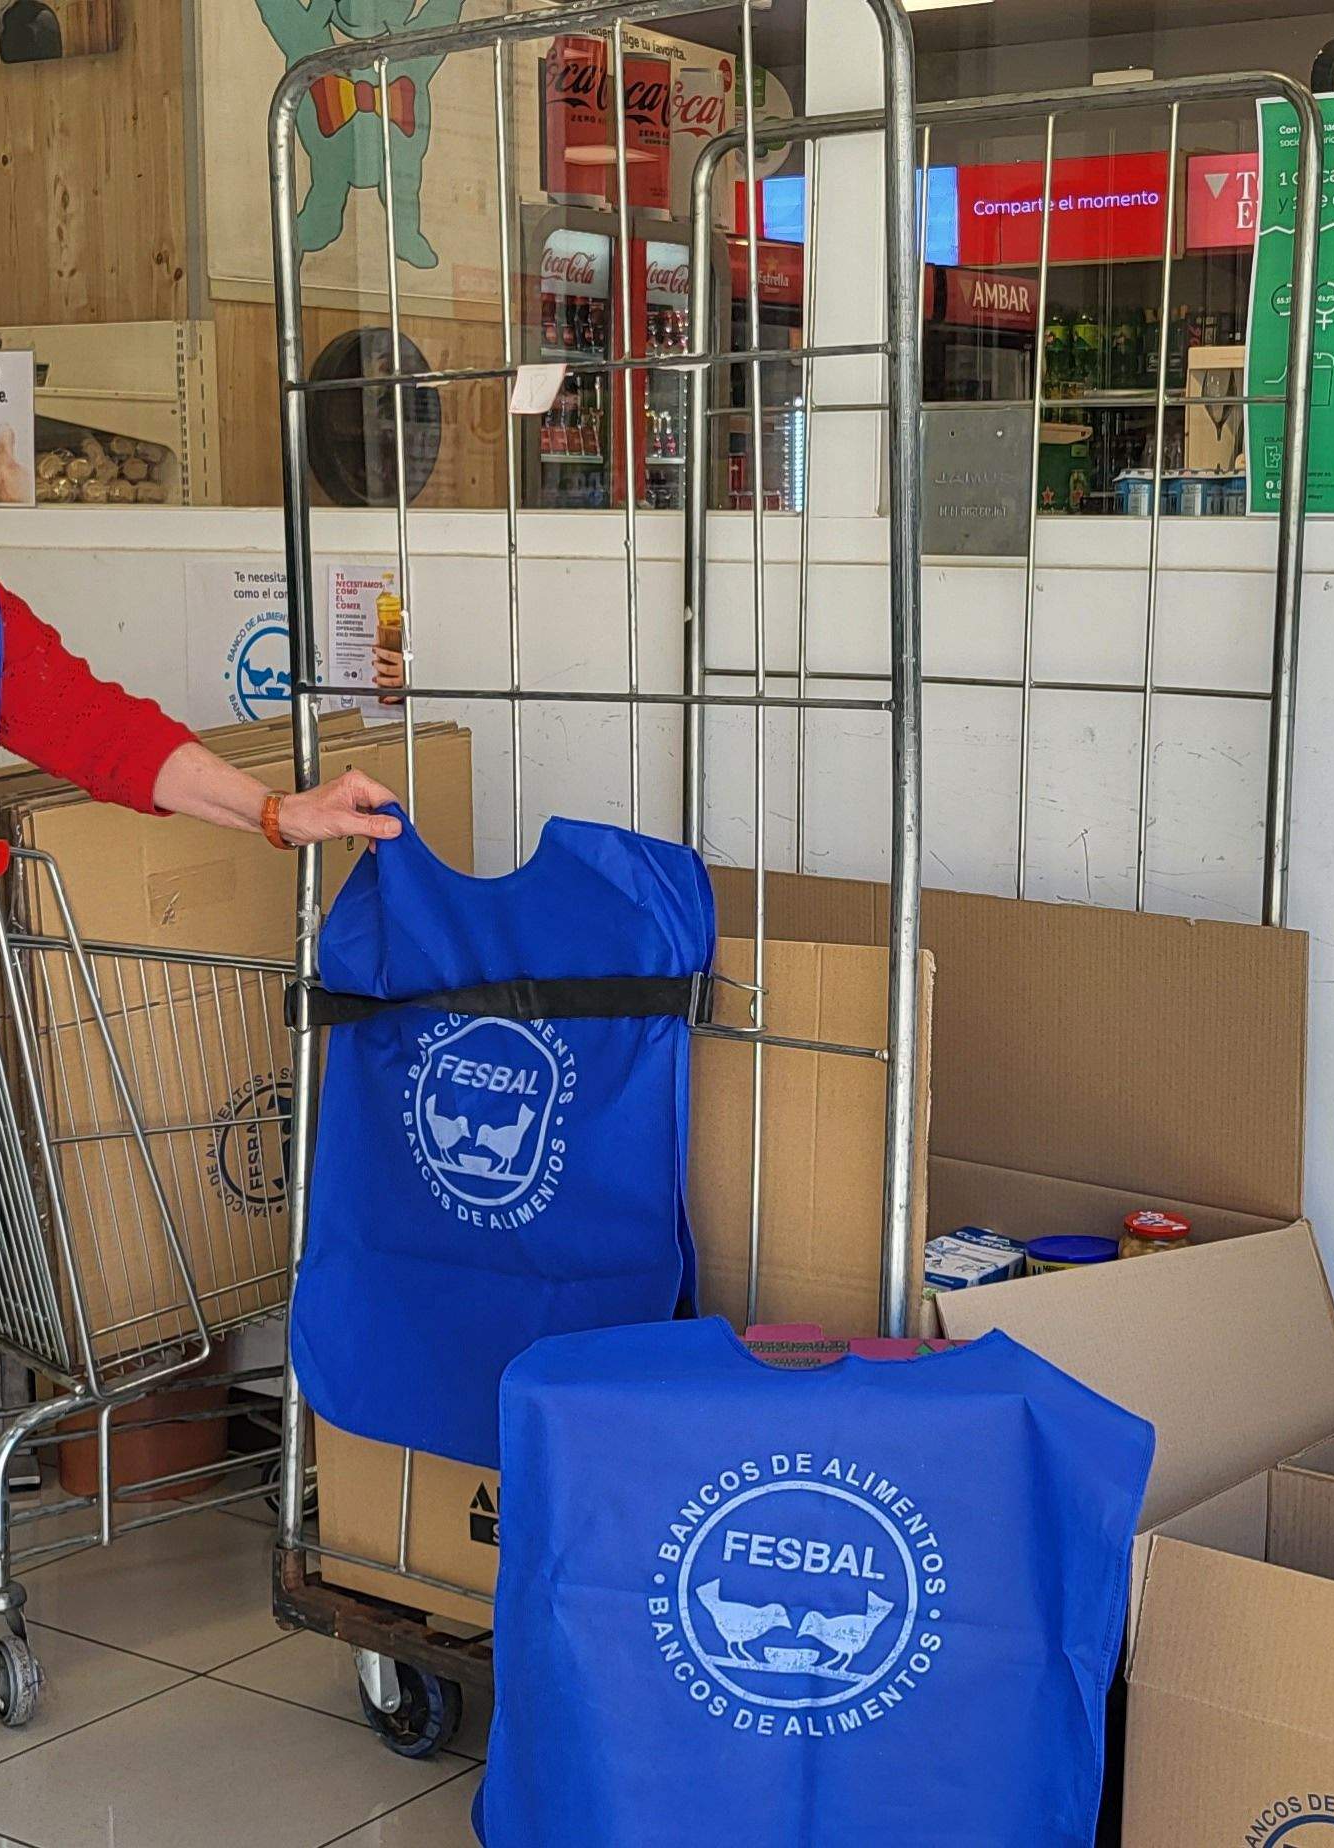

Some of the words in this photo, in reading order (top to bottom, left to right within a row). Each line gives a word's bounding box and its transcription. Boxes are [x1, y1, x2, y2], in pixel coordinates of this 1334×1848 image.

[1058, 200, 1074, 213] el
[1077, 190, 1160, 209] momento
[1278, 199, 1288, 215] y
[972, 280, 1031, 314] AMBAR
[233, 589, 260, 600] como
[263, 587, 271, 600] el
[235, 571, 246, 583] Te
[247, 570, 287, 584] necesita
[226, 627, 248, 664] BANCO
[244, 616, 260, 632] DE
[436, 1054, 540, 1096] FESBAL
[402, 1110, 451, 1211] BANCOS
[457, 1206, 484, 1230] DE
[488, 1138, 566, 1231] ALIMENTOS
[658, 1461, 761, 1563] BANCOS
[771, 1453, 813, 1476] DE
[821, 1458, 947, 1596] ALIMENTOS
[722, 1529, 886, 1581] FESBAL
[648, 1597, 729, 1718] BANCOS
[733, 1708, 775, 1736] DE
[783, 1631, 942, 1738] ALIMENTOS
[1244, 1795, 1304, 1848] ANCOS
